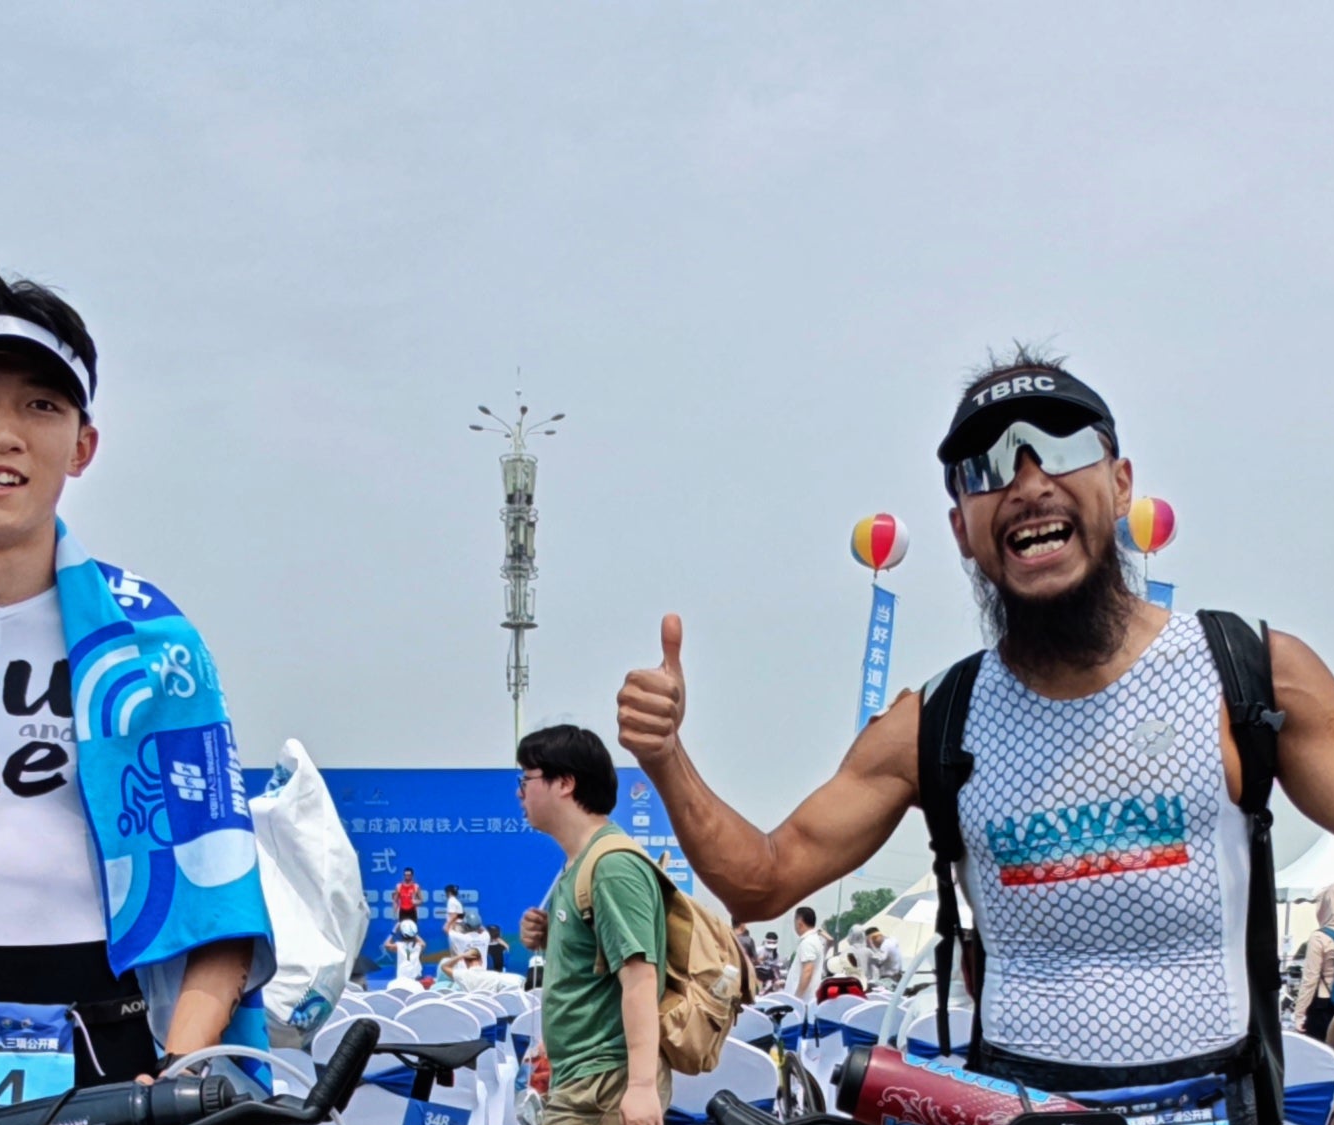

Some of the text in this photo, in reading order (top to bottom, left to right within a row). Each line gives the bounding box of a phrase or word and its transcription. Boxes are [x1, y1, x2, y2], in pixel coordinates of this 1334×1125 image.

[972, 375, 1056, 407] TBRC
[864, 604, 891, 709] 当好东道主
[342, 817, 546, 834] 堂成渝双城铁人三项公开
